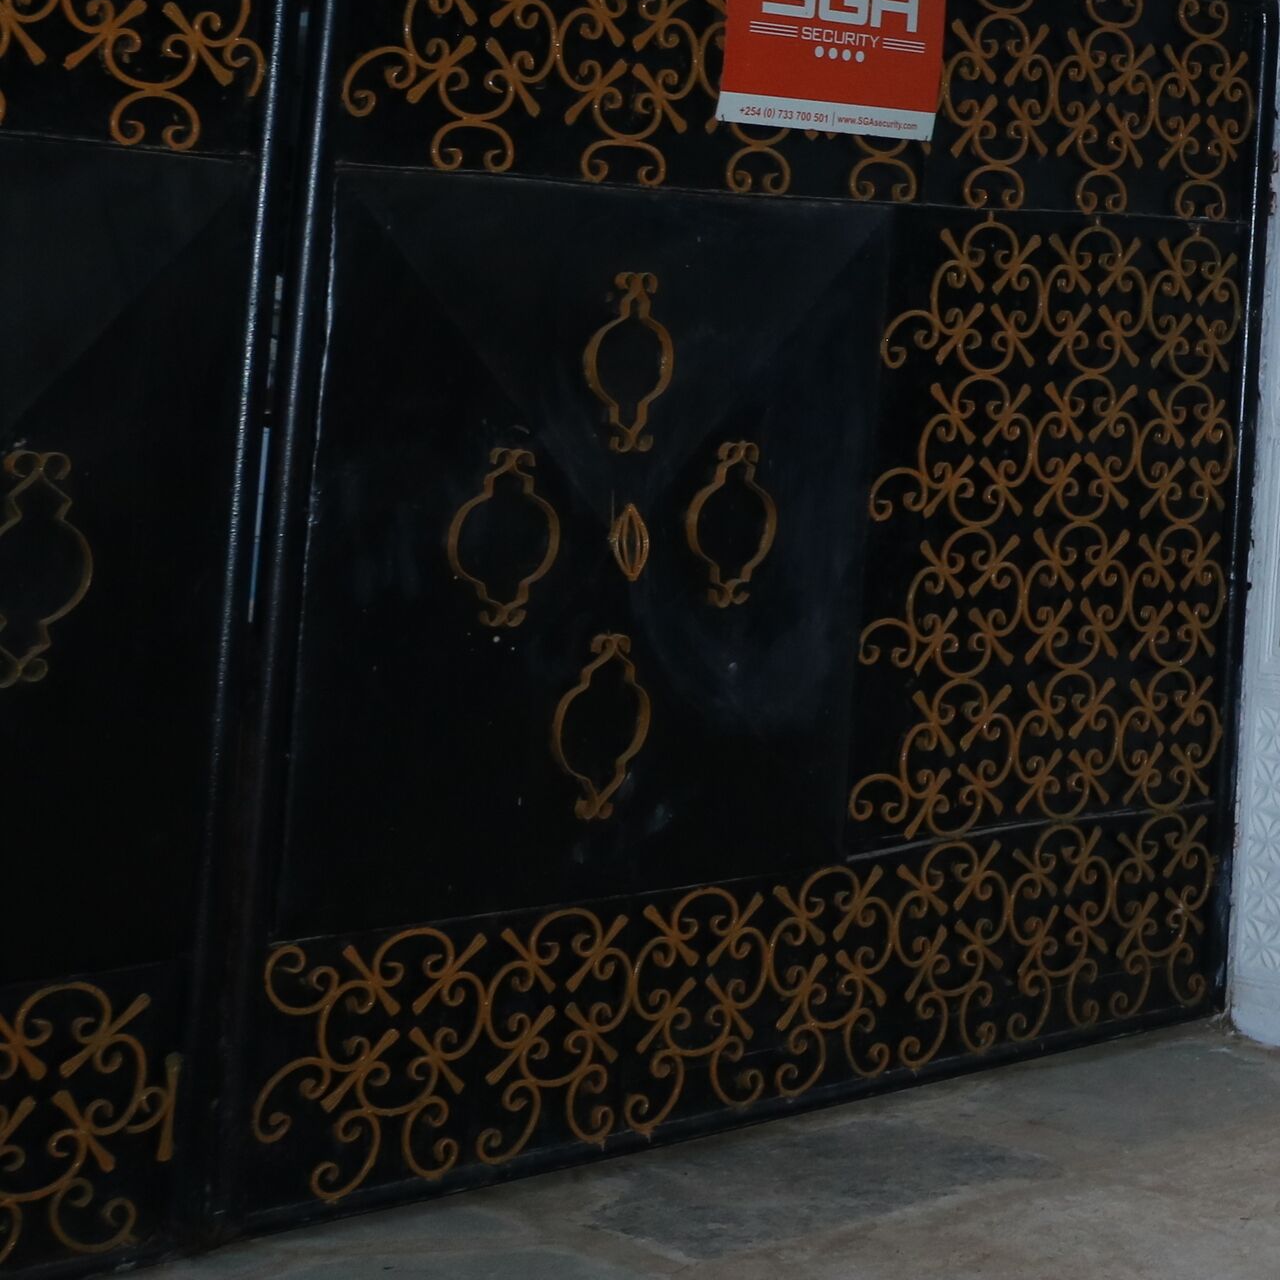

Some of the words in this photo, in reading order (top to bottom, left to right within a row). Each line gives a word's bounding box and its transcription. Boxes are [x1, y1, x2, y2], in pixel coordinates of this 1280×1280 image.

[800, 26, 880, 49] SECURITY
[739, 106, 761, 117] +254
[763, 107, 775, 119] (0)
[778, 109, 793, 120] 733
[796, 111, 811, 121] 700
[813, 112, 829, 123] 501
